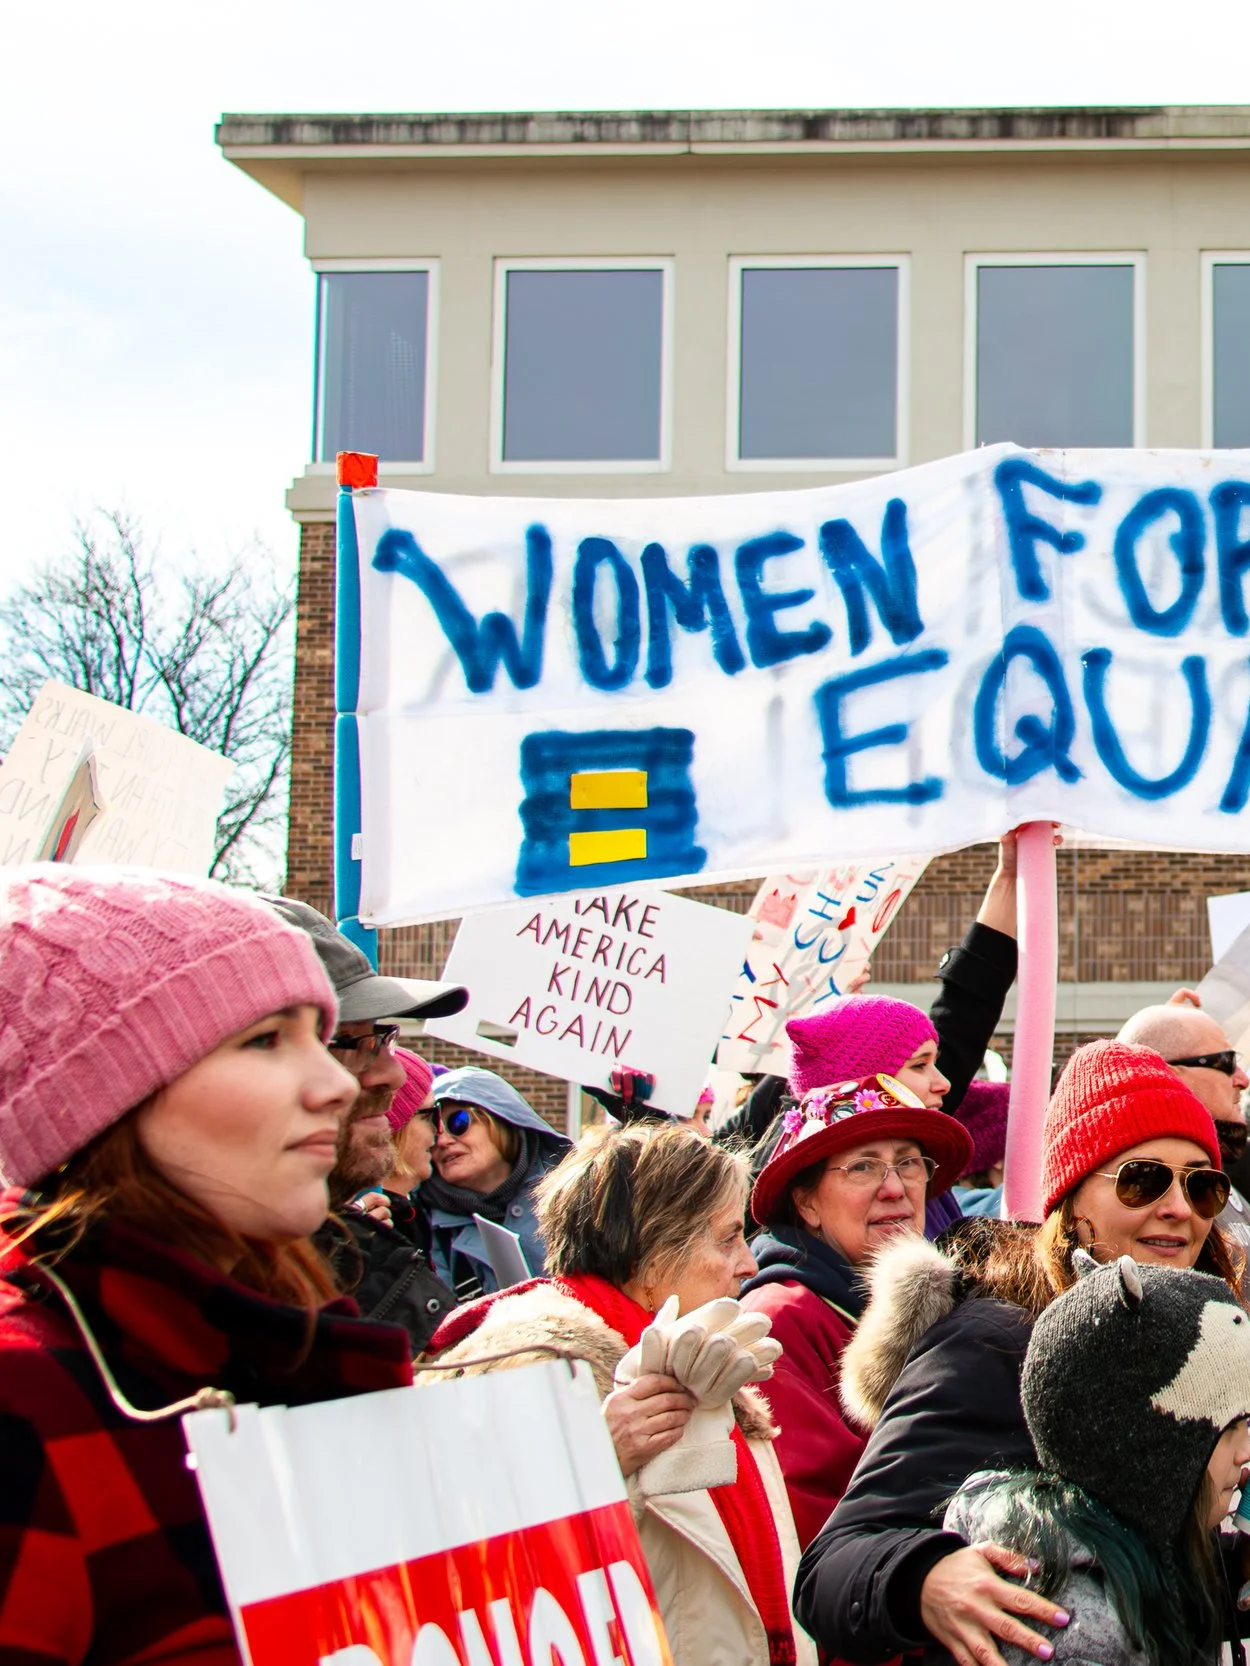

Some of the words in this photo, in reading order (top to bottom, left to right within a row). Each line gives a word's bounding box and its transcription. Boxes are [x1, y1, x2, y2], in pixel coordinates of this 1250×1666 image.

[373, 496, 925, 694] WOMEN
[575, 894, 661, 938] AKE
[516, 912, 668, 984] AMERICA
[548, 963, 633, 1016] KIND
[508, 996, 633, 1058] AGAIN
